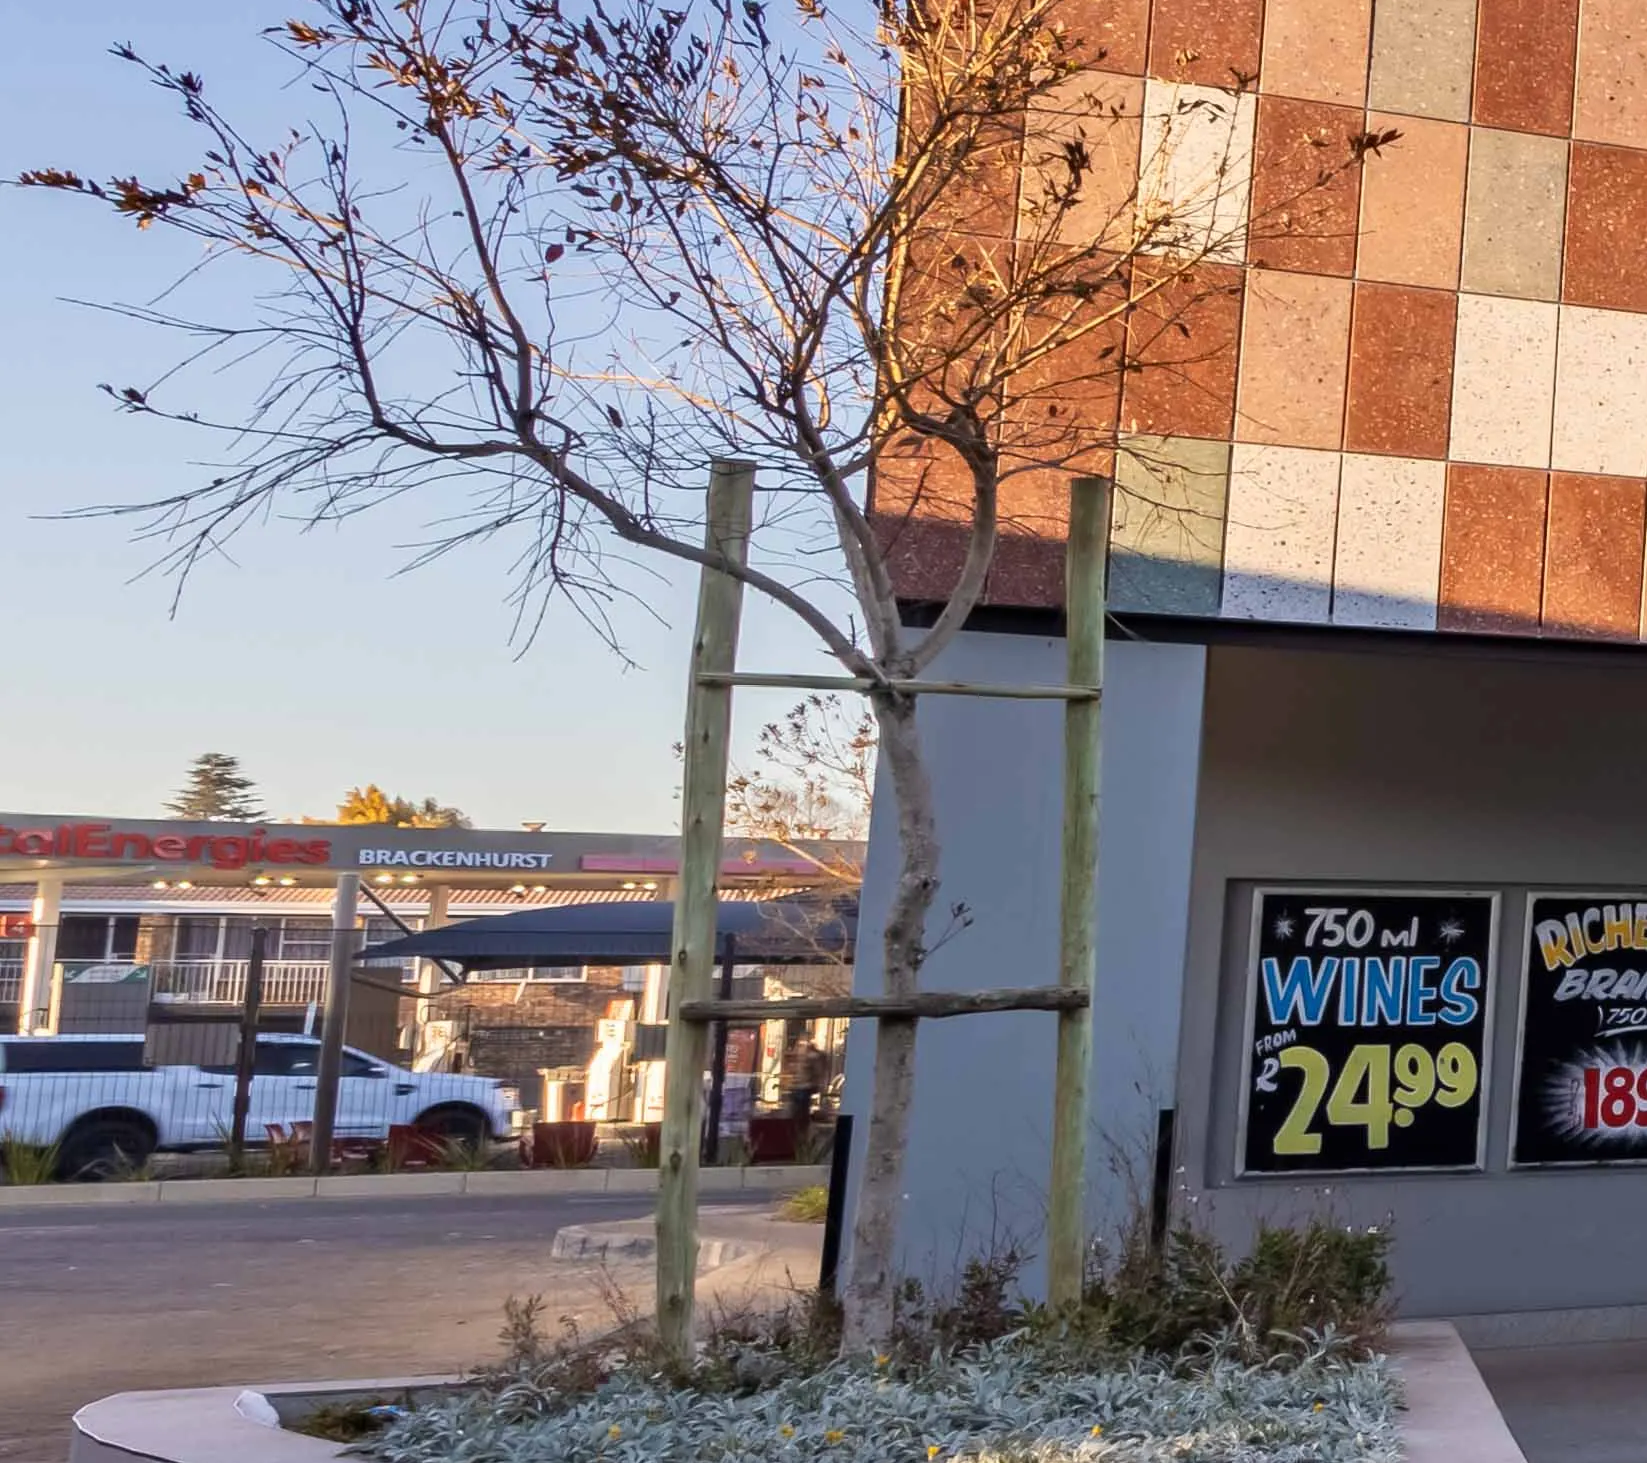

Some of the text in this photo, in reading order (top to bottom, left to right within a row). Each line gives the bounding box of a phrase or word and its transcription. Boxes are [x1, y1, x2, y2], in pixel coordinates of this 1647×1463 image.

[359, 848, 552, 869] BRACKENHURST
[1304, 908, 1375, 948] 750
[1262, 956, 1480, 1026] WINES
[1606, 1007, 1647, 1024] 750
[1256, 1028, 1297, 1056] FROM
